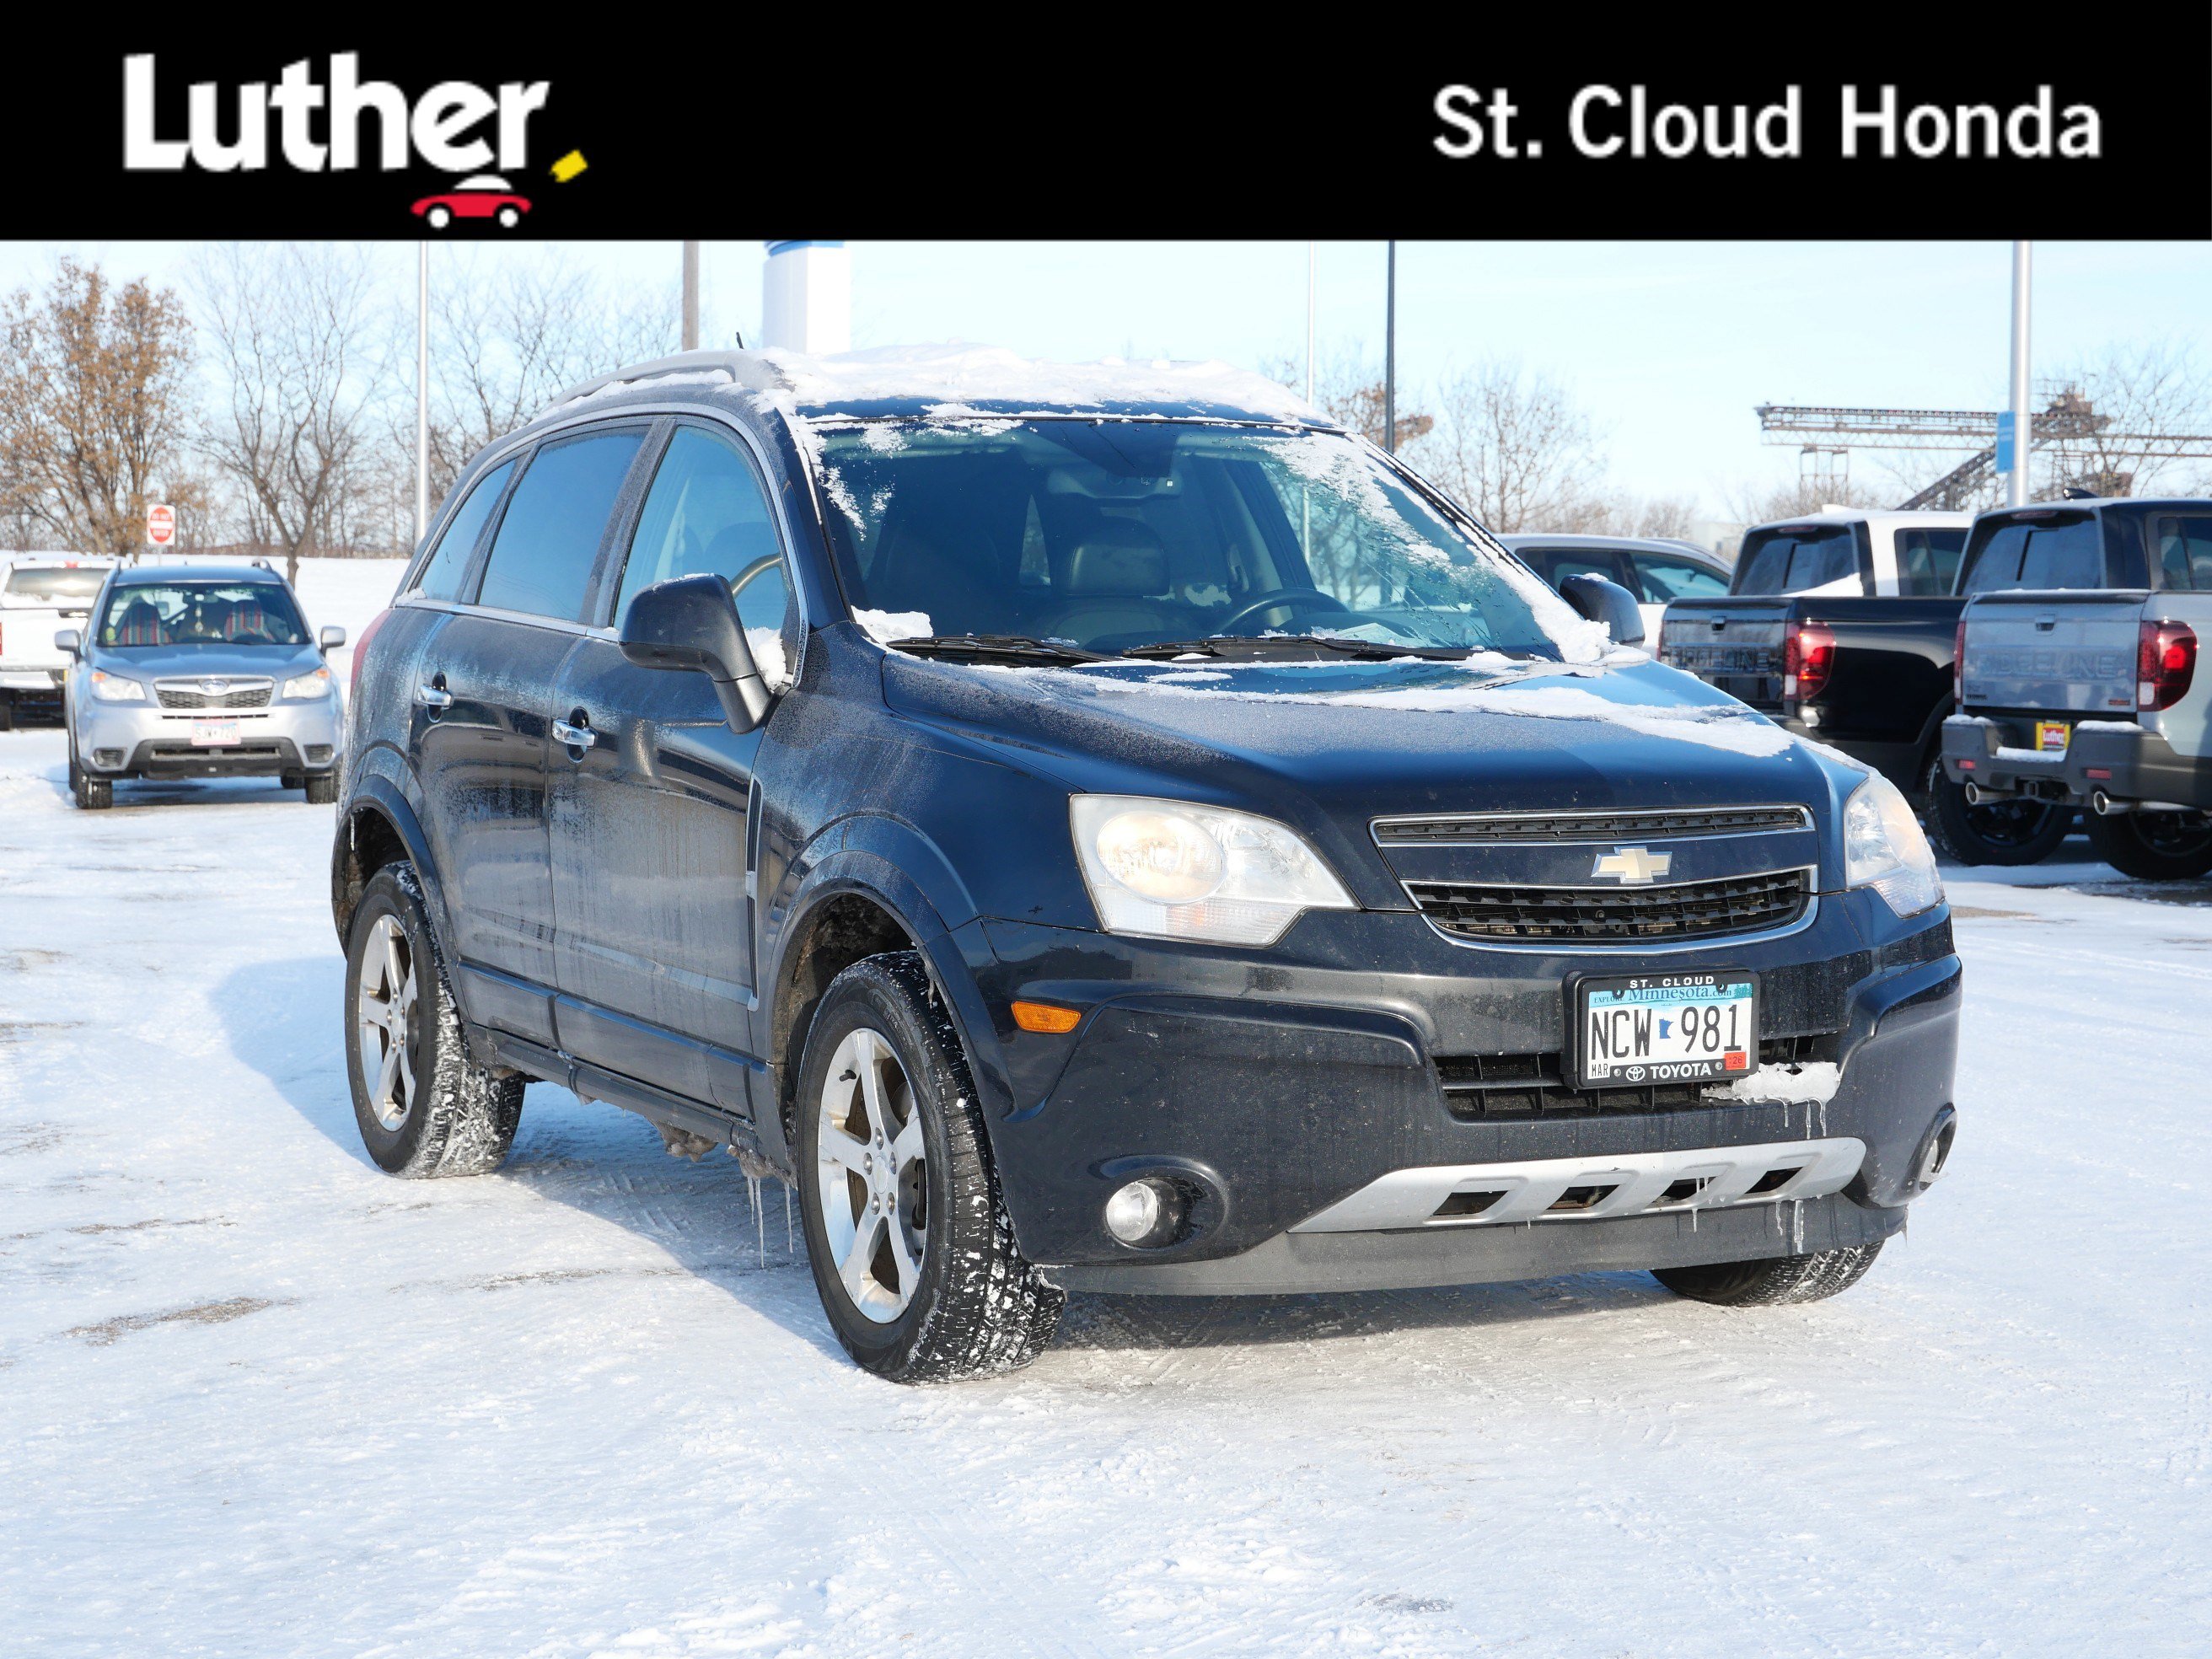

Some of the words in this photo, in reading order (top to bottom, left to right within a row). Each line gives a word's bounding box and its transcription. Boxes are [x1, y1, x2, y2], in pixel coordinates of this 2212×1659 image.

[1629, 979, 1653, 989] ST.
[1662, 975, 1715, 987] CLOUD
[1591, 1008, 1652, 1060] NCW
[1681, 1004, 1742, 1053] 981
[1592, 1063, 1608, 1077] MAR
[1650, 1062, 1712, 1079] TOYOTA
